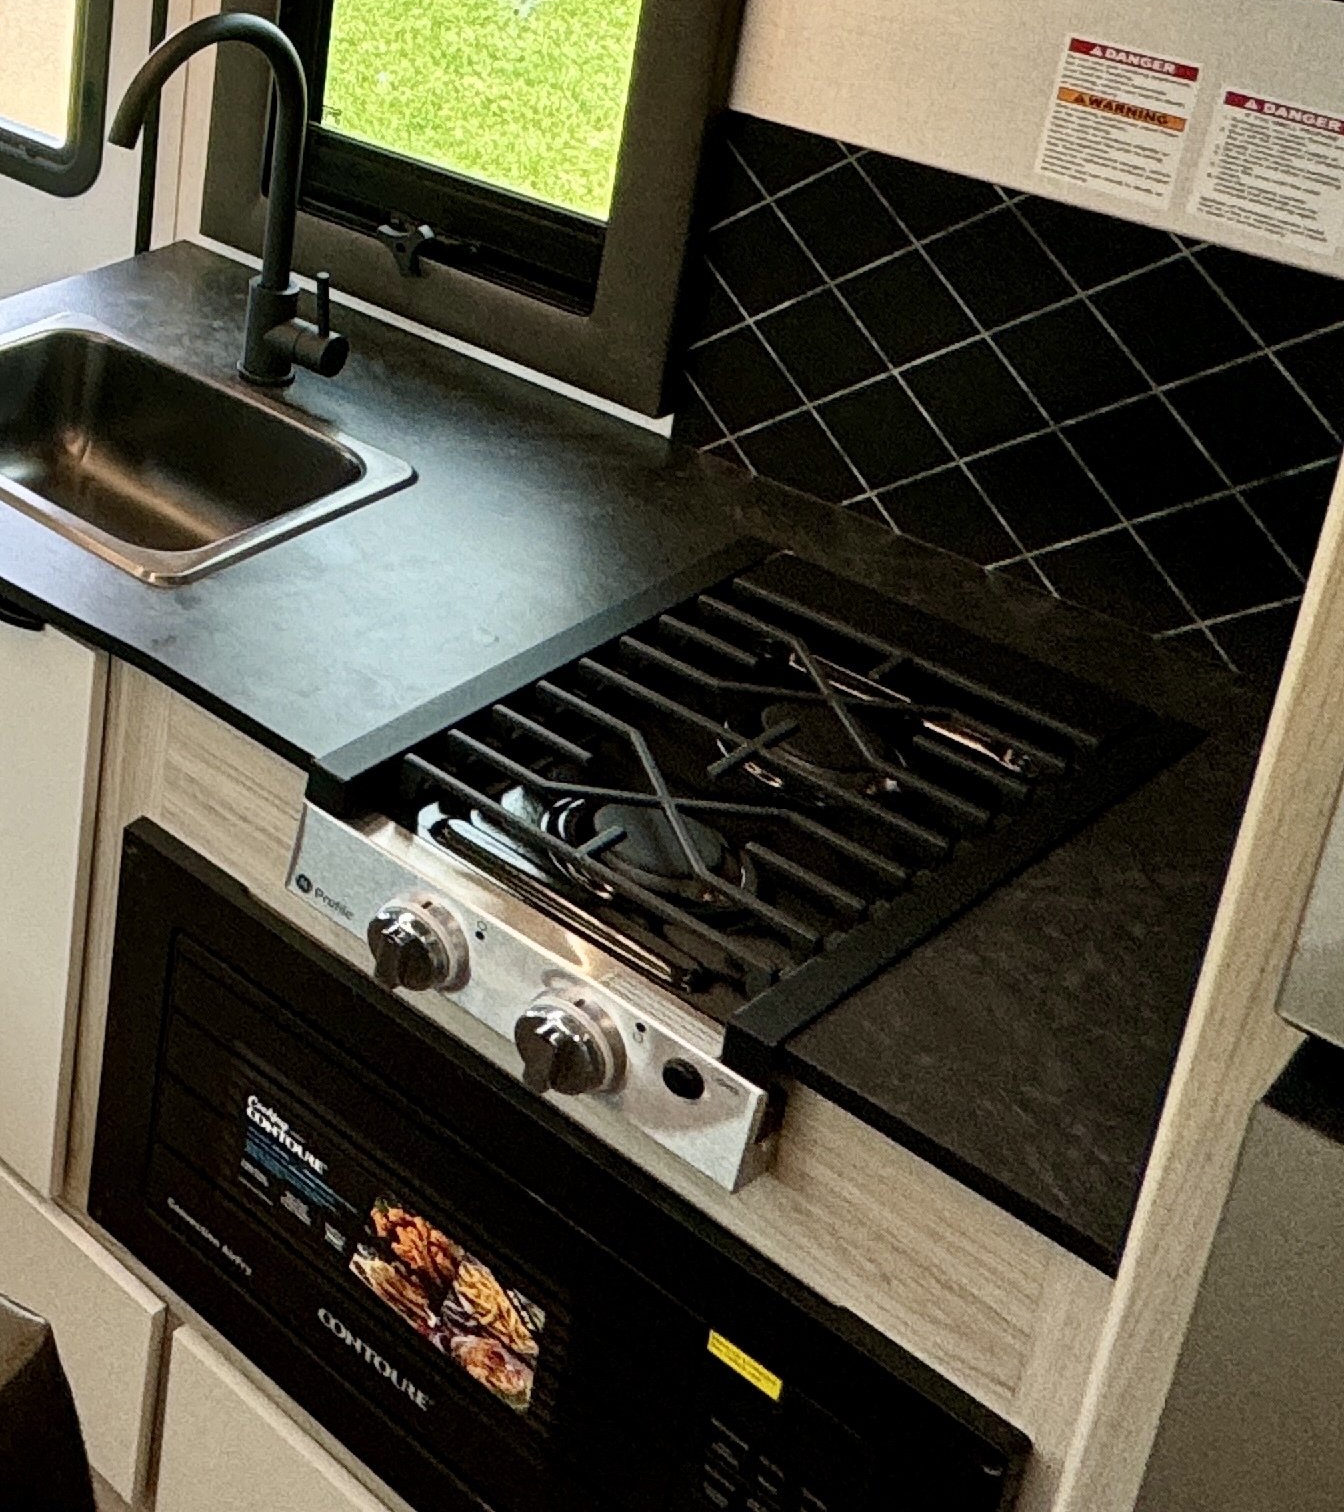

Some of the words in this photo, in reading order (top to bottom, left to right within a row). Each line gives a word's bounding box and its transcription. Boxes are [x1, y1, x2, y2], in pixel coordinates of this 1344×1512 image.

[1104, 48, 1177, 75] DANGER
[1088, 94, 1169, 125] WARNING
[1263, 102, 1342, 132] DANGER
[314, 887, 354, 920] Profile
